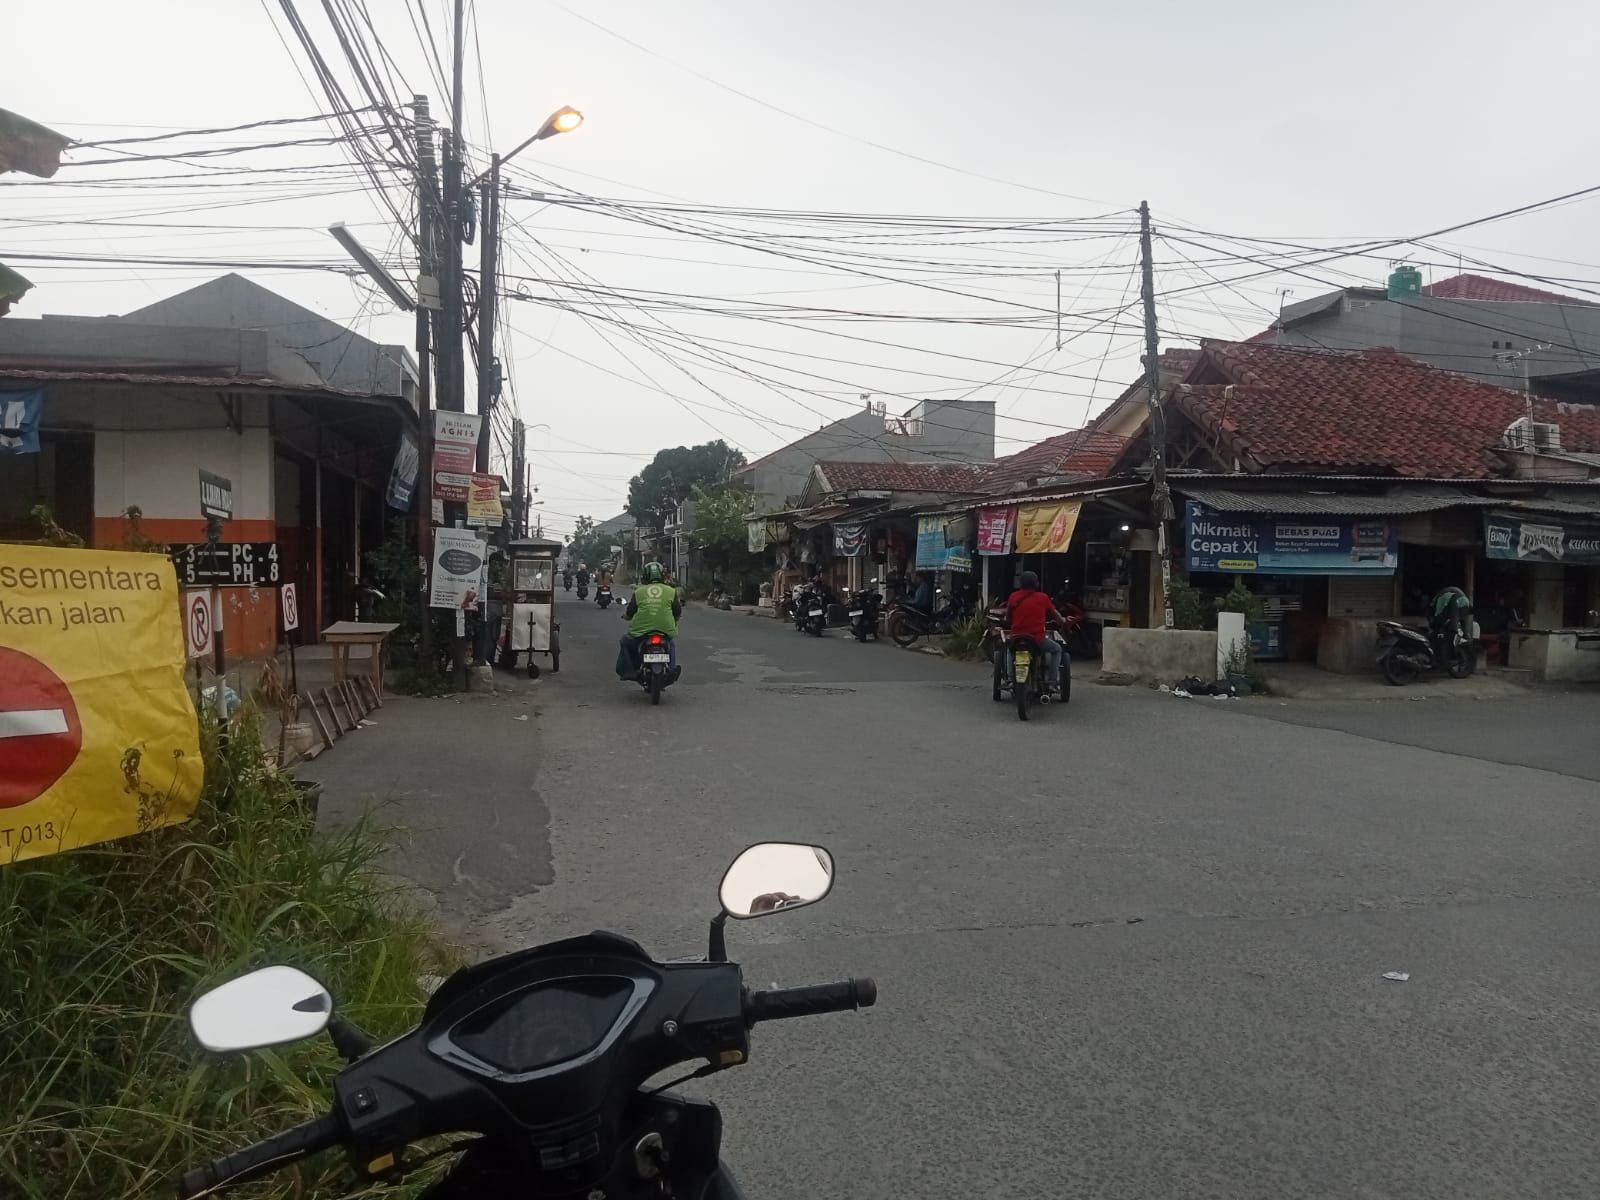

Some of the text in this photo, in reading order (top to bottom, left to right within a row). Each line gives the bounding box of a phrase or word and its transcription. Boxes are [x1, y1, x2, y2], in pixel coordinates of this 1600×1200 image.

[1191, 522, 1251, 538] Nikmati
[1190, 538, 1239, 555] Cepat
[1, 565, 162, 591] sementara
[0, 600, 126, 631] kan jalan
[21, 821, 55, 844] 013
